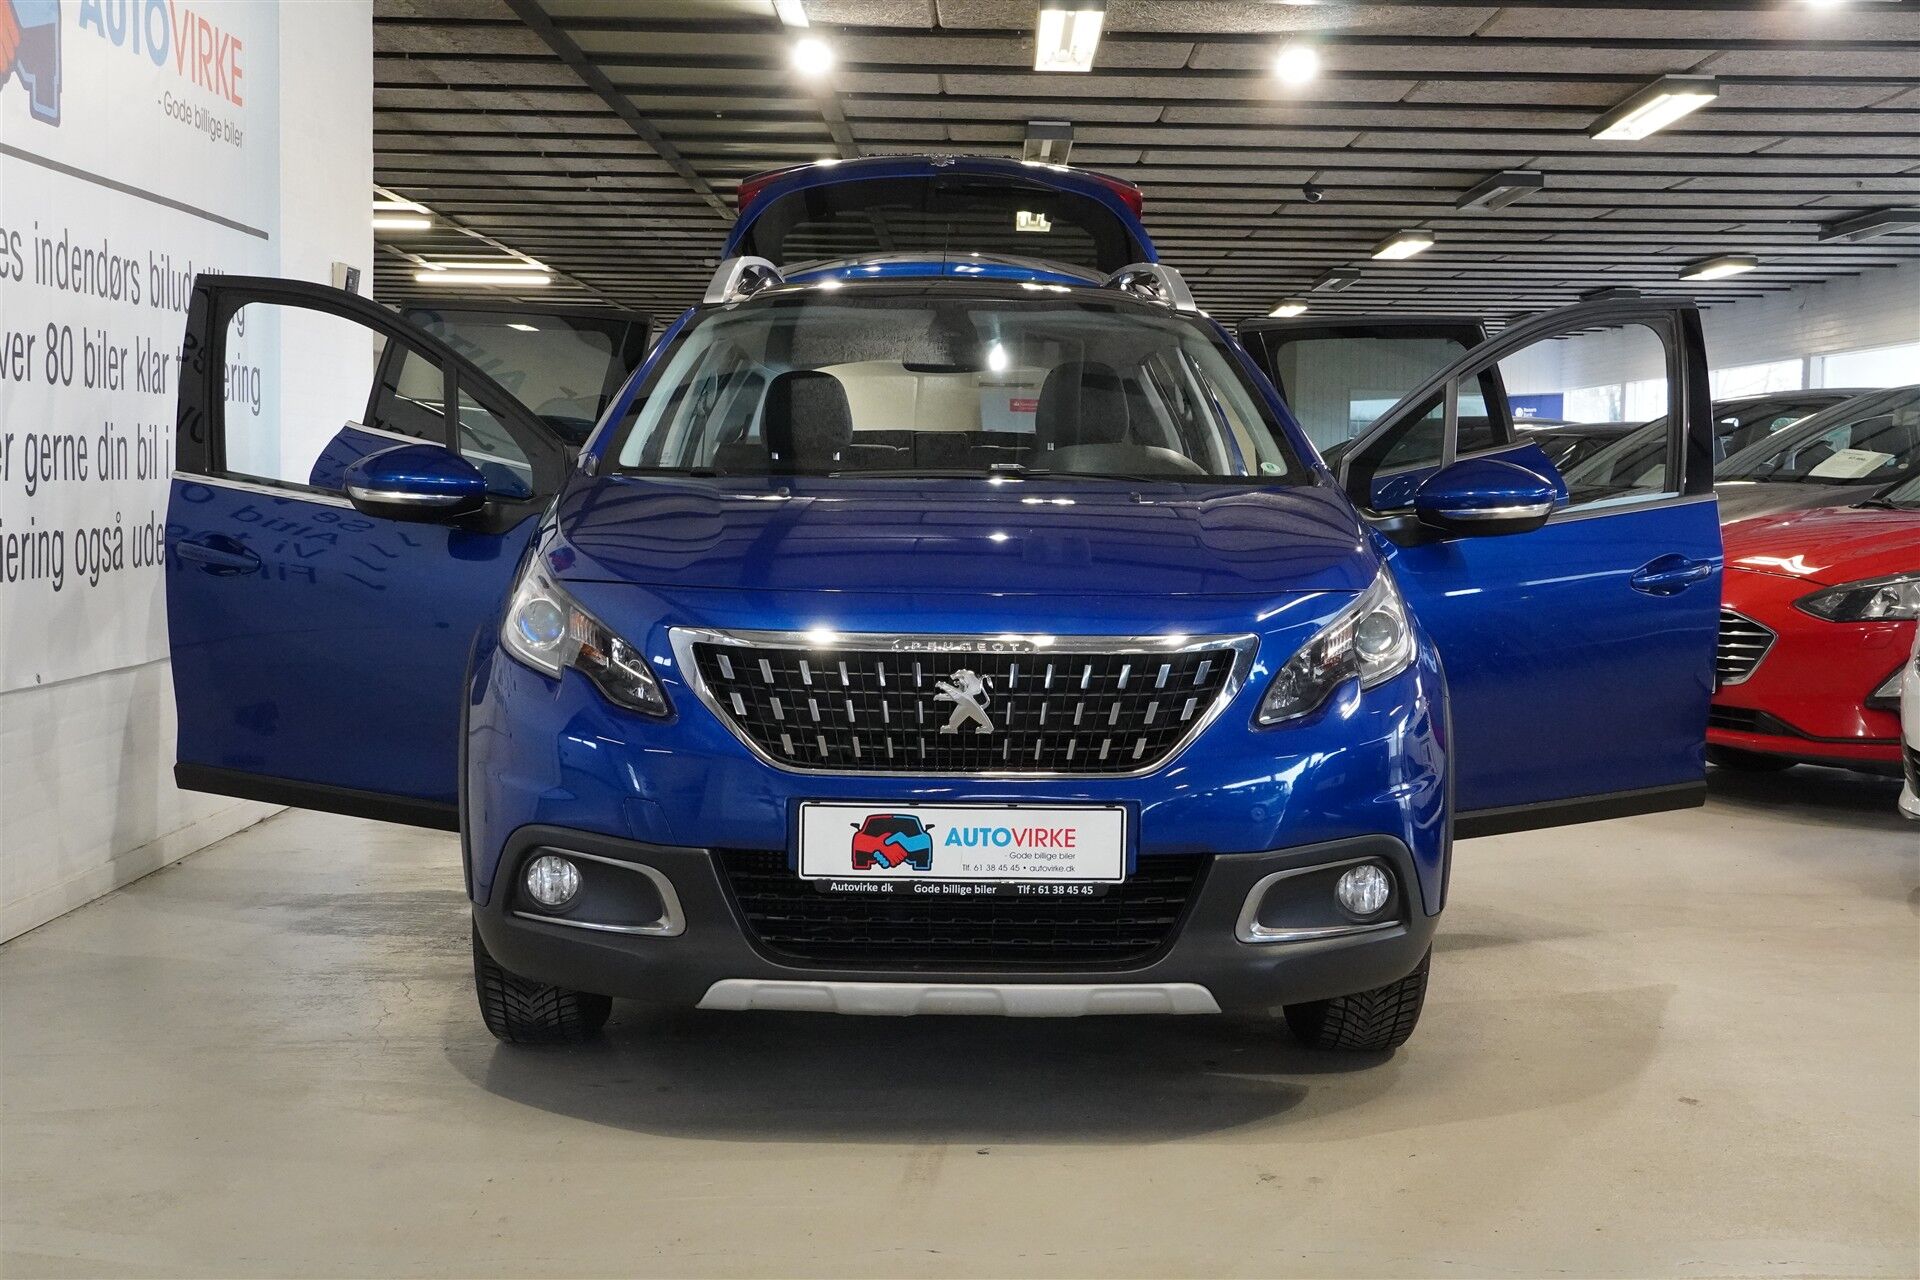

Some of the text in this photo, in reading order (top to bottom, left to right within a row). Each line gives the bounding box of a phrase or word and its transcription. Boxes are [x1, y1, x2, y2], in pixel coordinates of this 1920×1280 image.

[164, 90, 192, 125] Gode
[194, 104, 222, 142] billige
[224, 119, 243, 148] biler
[35, 221, 140, 305] indendørs
[46, 322, 73, 387] 80
[83, 327, 128, 391] biler
[136, 336, 169, 394] klar
[25, 433, 87, 497] gerne
[98, 422, 128, 481] din
[137, 424, 158, 480] bil
[75, 512, 123, 587] også
[944, 827, 1076, 848] AUTOVIRKE
[1009, 852, 1032, 860] Gode
[1034, 851, 1057, 861] billige
[1058, 852, 1076, 860] biler
[830, 882, 878, 893] Autovirke
[881, 882, 893, 893] dk
[913, 884, 940, 894] Gode
[942, 884, 972, 896] billige
[974, 885, 997, 895] biler
[1017, 885, 1030, 894] Tlf
[1038, 885, 1050, 895] 61
[1052, 885, 1065, 895] 38
[1066, 885, 1079, 895] 45
[1081, 885, 1093, 895] 45
[973, 864, 983, 872] 61
[986, 864, 996, 872] 38
[998, 864, 1008, 872] 45
[1010, 864, 1020, 872] 45
